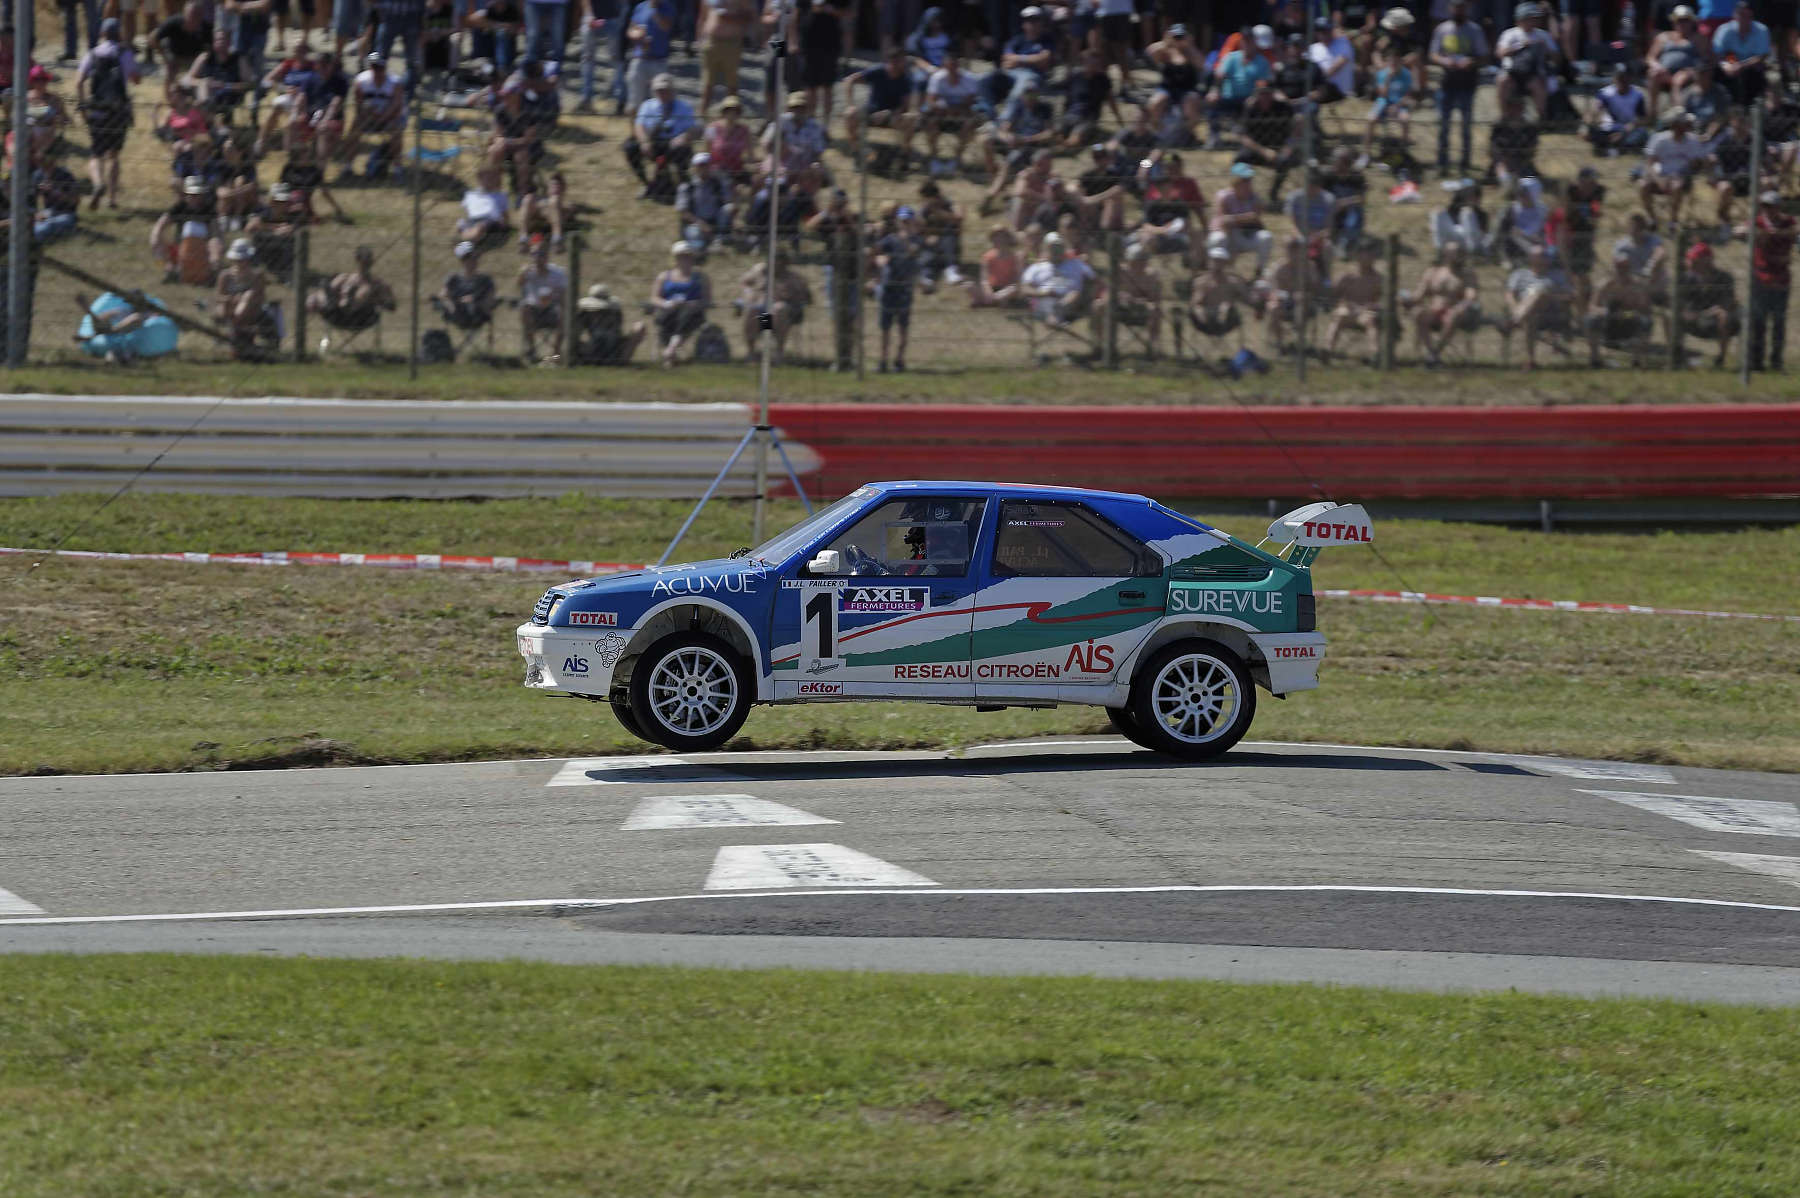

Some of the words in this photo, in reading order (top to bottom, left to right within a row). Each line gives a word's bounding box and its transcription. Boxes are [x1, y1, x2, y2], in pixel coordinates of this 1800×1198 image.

[1303, 521, 1372, 542] TOTAL
[651, 572, 757, 597] ACUVUE
[852, 589, 916, 602] AXEL
[1171, 589, 1283, 614] SUREVUE
[850, 602, 916, 610] FERMETURES
[571, 612, 616, 625] TOTAL
[806, 593, 833, 658] 1
[1274, 647, 1317, 658] TOTAL
[894, 664, 970, 678] RESEAU
[977, 661, 1060, 678] CITROËN
[800, 682, 840, 693] eKtor
